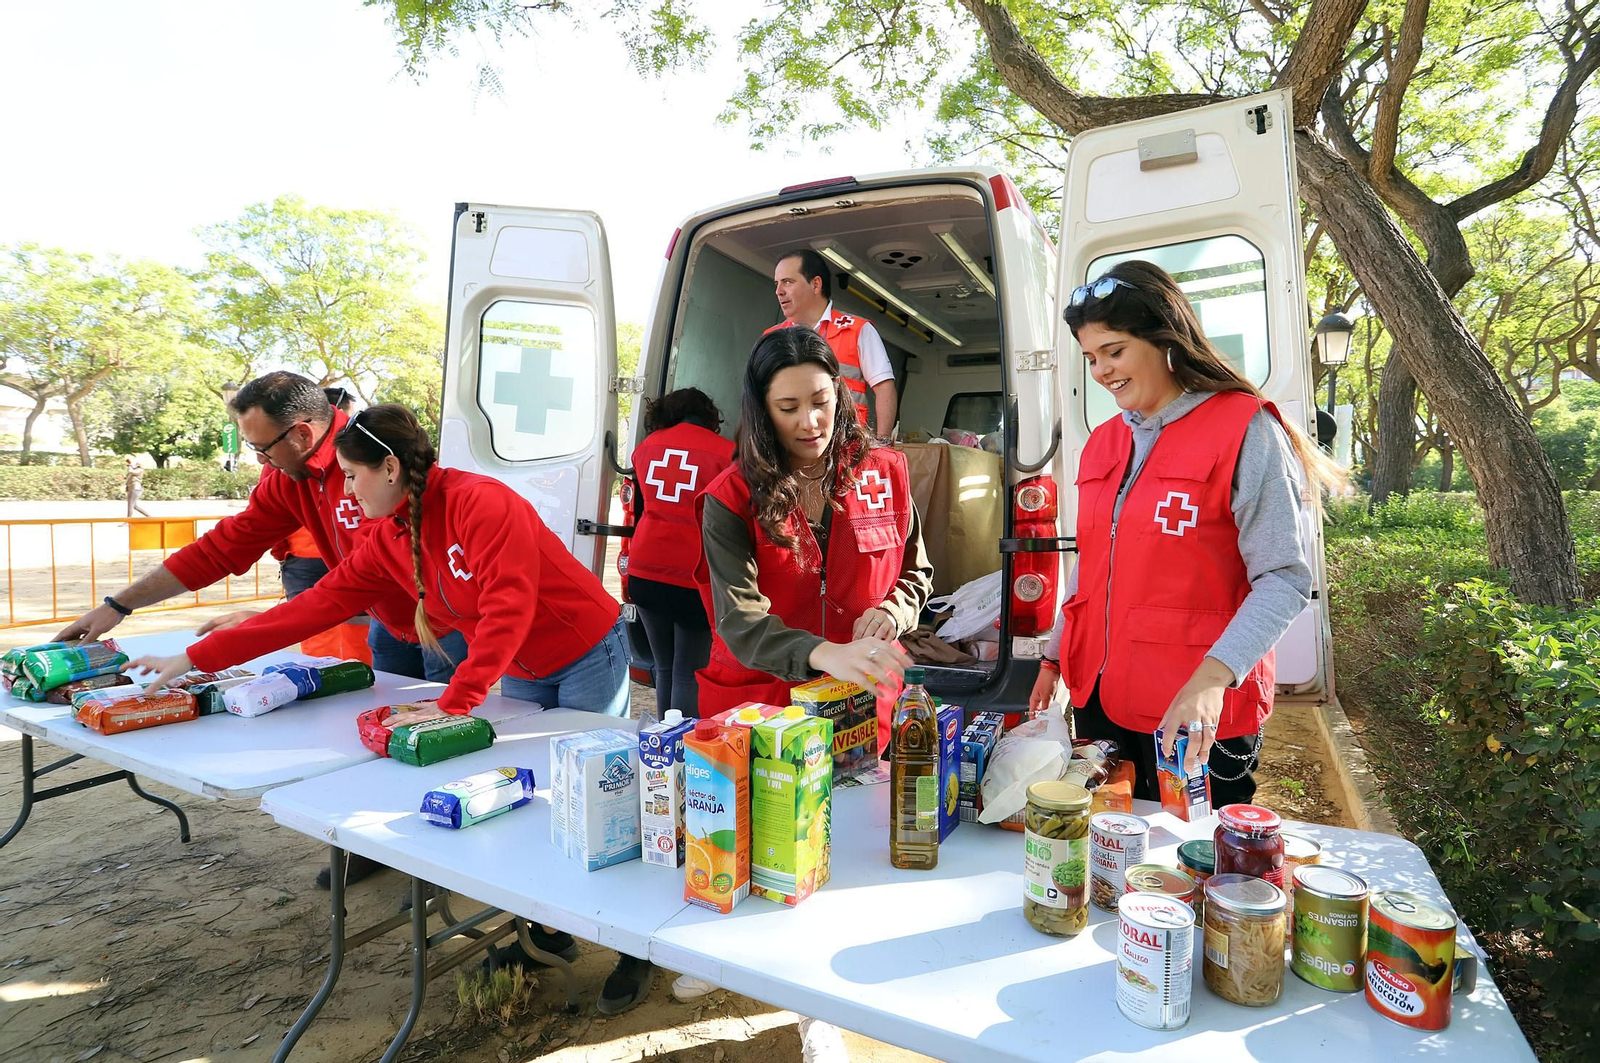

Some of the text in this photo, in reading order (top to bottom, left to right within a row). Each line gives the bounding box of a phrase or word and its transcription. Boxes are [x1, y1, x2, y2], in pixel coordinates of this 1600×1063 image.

[830, 685, 844, 694] PACK
[854, 691, 874, 706] mezcla
[231, 705, 243, 714] SOS
[823, 703, 846, 717] mezcla
[644, 753, 669, 763] PULEVA
[646, 770, 666, 780] Max
[604, 779, 631, 792] PRIMOR
[707, 793, 716, 802] de
[1025, 839, 1052, 862] BIO
[1308, 911, 1358, 927] GUISANTES
[1300, 951, 1341, 976] eliges
[1376, 963, 1410, 991] Cofrusa
[1399, 992, 1410, 1001] DE
